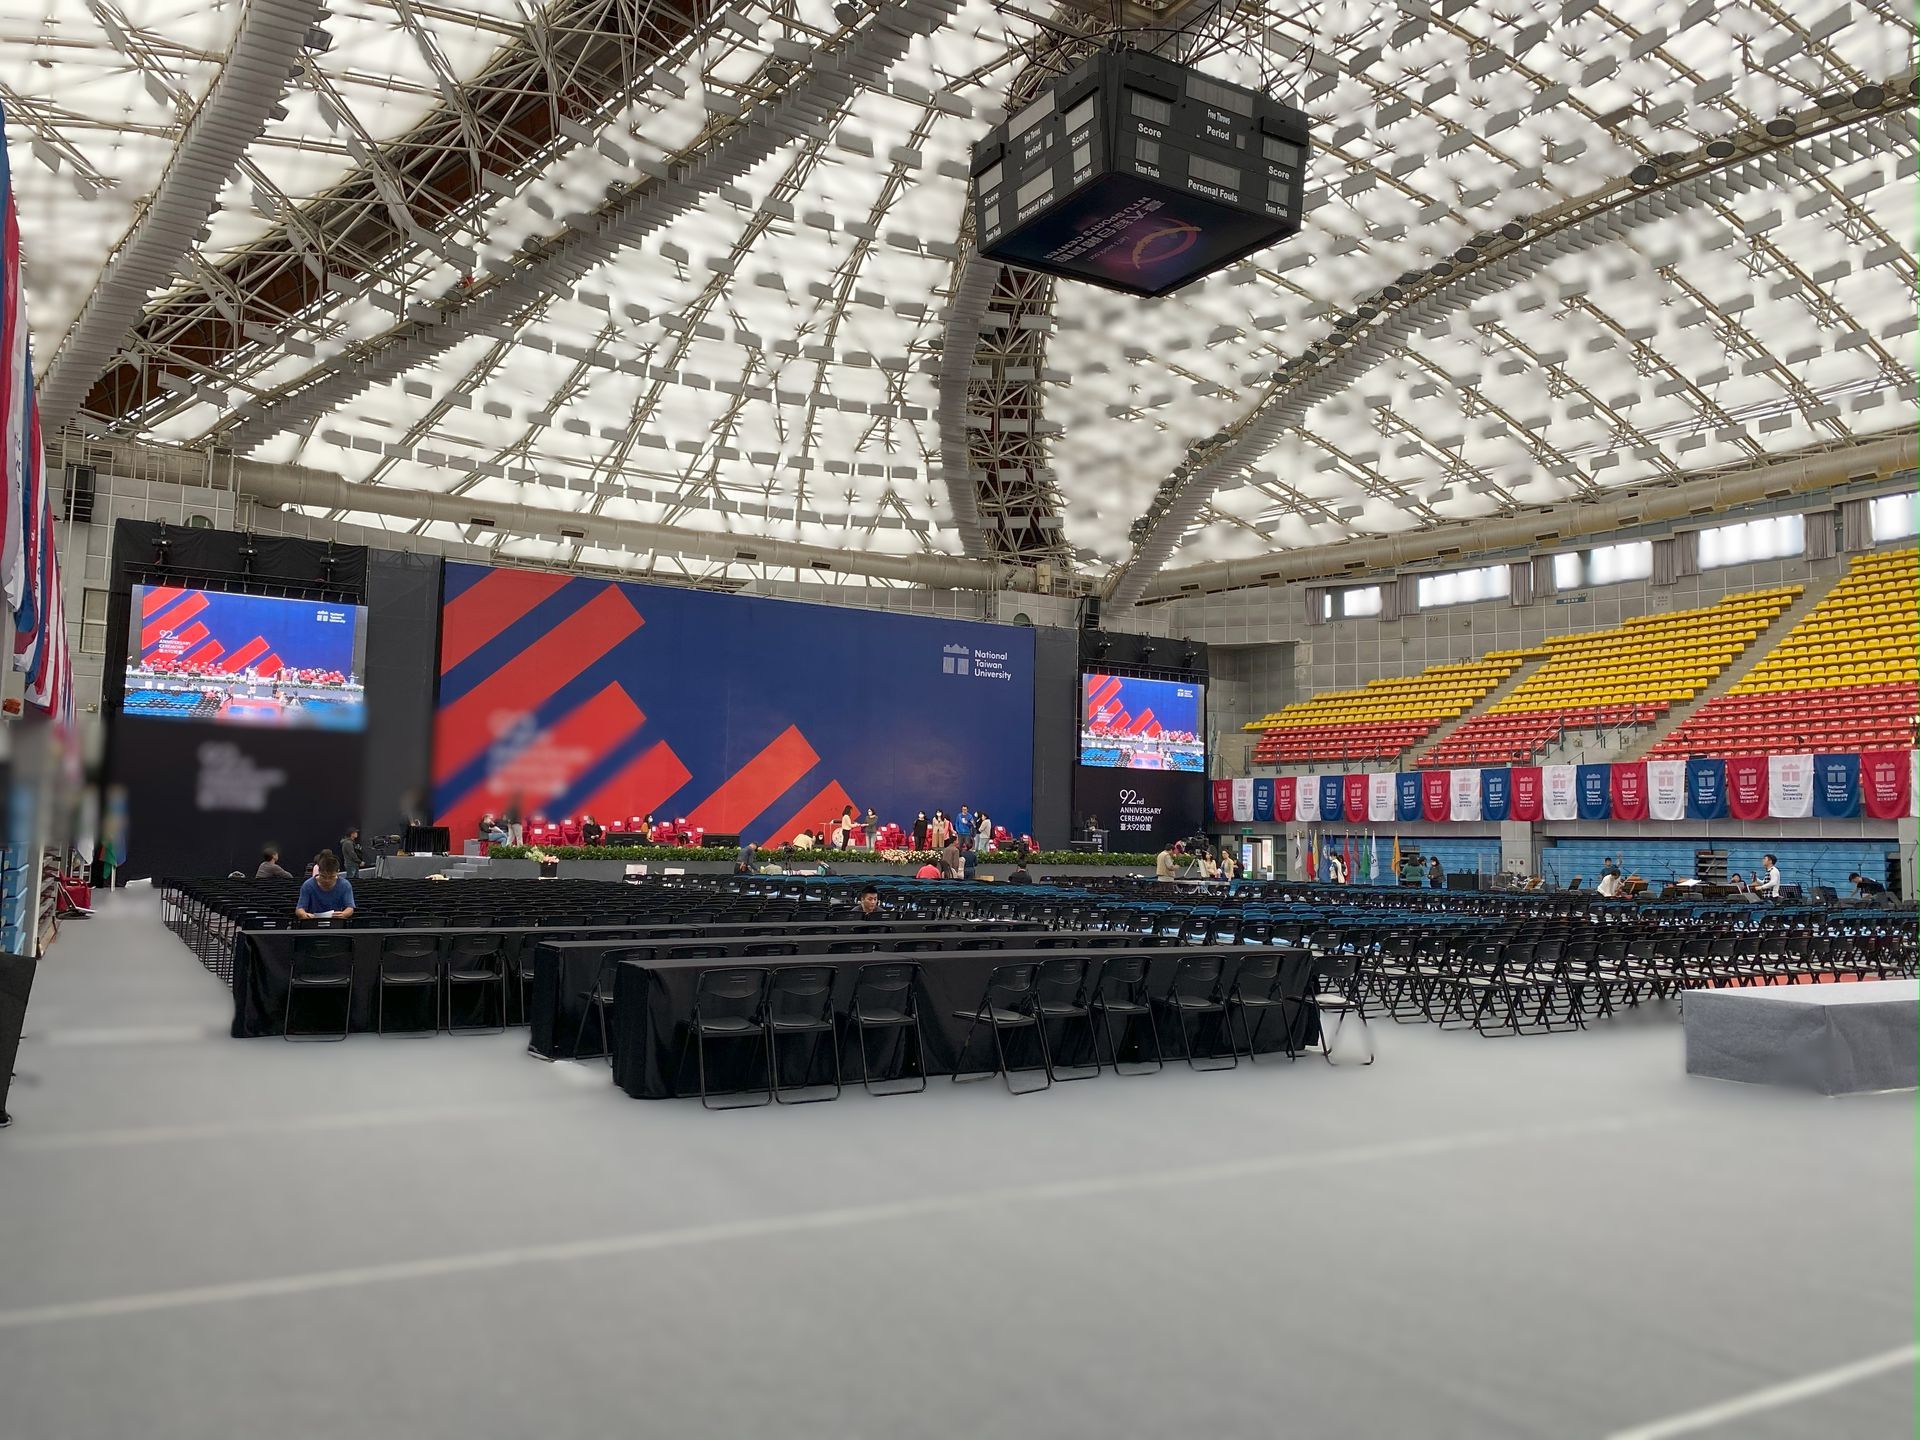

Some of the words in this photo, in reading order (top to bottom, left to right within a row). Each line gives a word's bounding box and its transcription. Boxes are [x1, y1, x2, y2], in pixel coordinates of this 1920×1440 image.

[1208, 109, 1217, 120] Free
[1071, 130, 1089, 146] Score
[1137, 123, 1162, 138] Score
[1206, 126, 1230, 140] Period
[1025, 142, 1042, 160] Period
[1135, 163, 1147, 173] Team
[1148, 166, 1160, 178] Fouls
[1268, 165, 1290, 180] Score
[1188, 179, 1219, 197] Personal
[1220, 189, 1238, 202] Fouls
[984, 192, 1000, 207] Score
[1018, 200, 1040, 221] Personal
[1040, 193, 1053, 207] Fouls
[1265, 203, 1276, 214] Team
[1277, 207, 1288, 218] Fouls
[1083, 211, 1126, 236] SPORTS
[1043, 236, 1084, 259] CENTER
[975, 650, 1007, 660] National
[975, 659, 1002, 669] Taiwan
[975, 668, 1011, 681] University
[1119, 789, 1145, 805] 92nd
